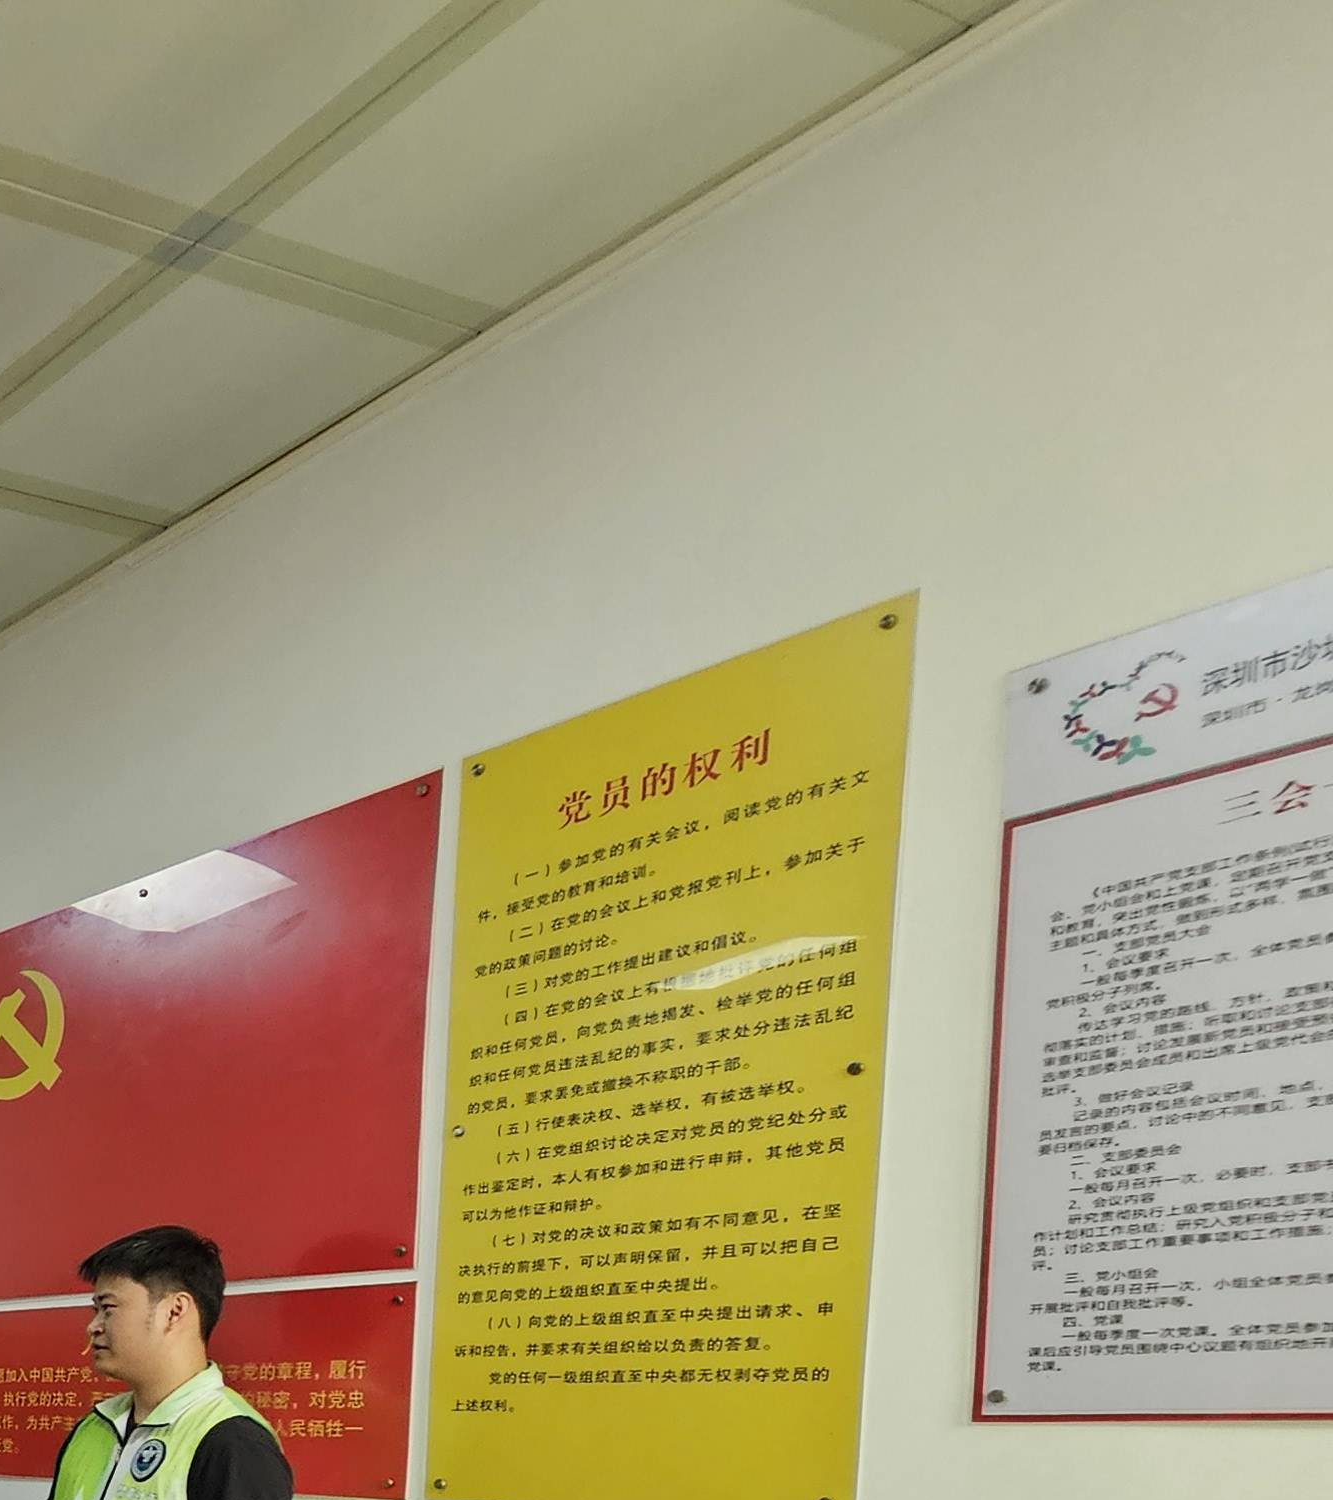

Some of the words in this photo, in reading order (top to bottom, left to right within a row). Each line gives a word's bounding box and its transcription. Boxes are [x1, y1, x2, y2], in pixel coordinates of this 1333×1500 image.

[557, 726, 772, 830] 党员的权利
[1217, 777, 1333, 826] 三会
[1070, 1161, 1157, 1181] 1、会议要求
[1068, 1192, 1156, 1211] 2、会议内容
[1064, 1267, 1159, 1284] 三、党小组会
[1062, 1314, 1124, 1328] 四、党课
[1026, 1360, 1062, 1373] 党课。
